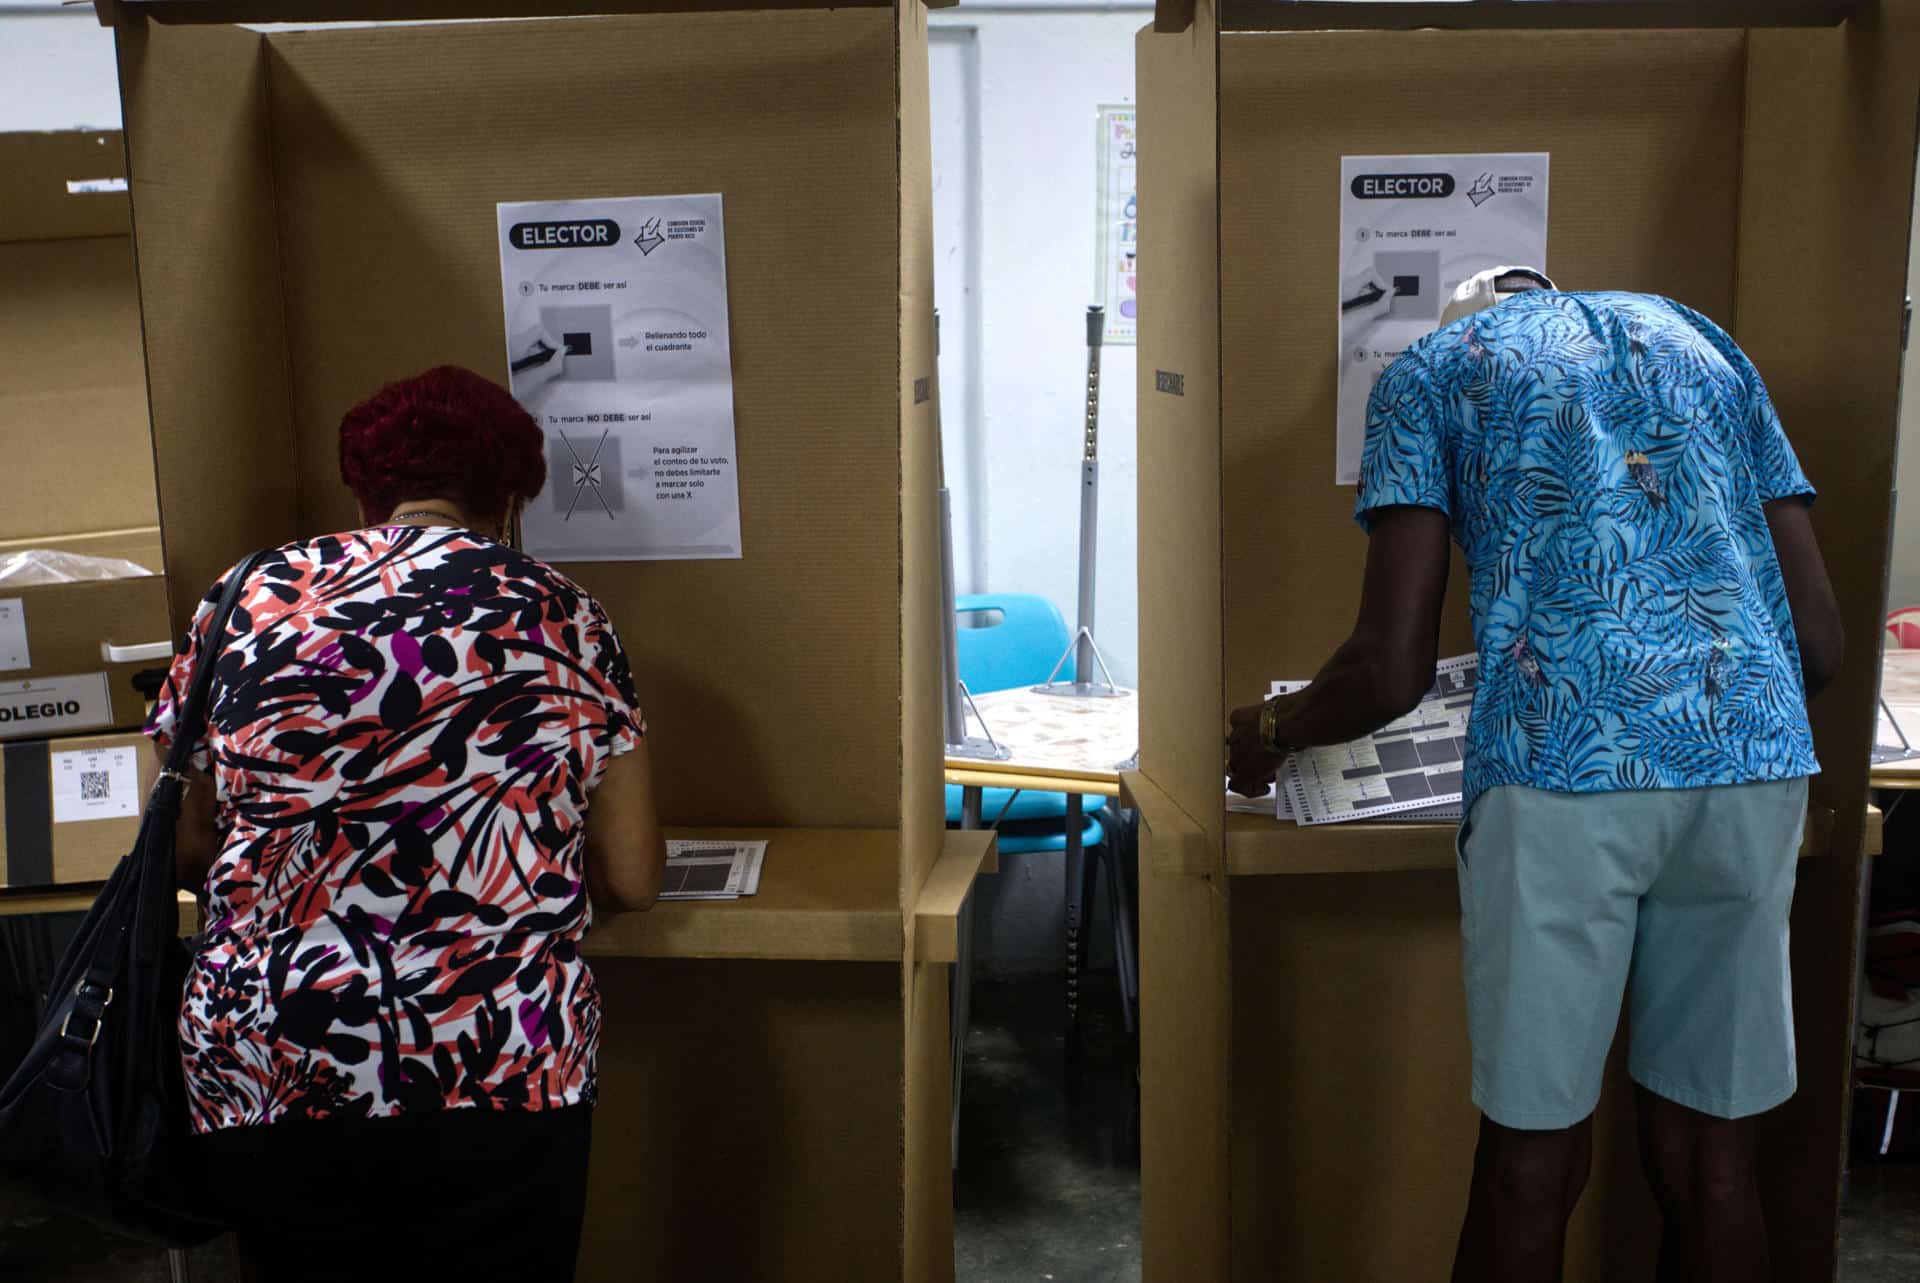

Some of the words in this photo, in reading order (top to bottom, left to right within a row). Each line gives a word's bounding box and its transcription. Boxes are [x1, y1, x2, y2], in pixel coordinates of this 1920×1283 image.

[1363, 178, 1443, 194] ELECTOR
[522, 226, 608, 245] ELECTOR
[1375, 230, 1384, 238] Tu
[539, 283, 548, 292] Tu
[551, 284, 575, 292] marca
[578, 281, 601, 291] DEBE
[616, 280, 627, 290] así
[645, 331, 687, 341] Rellenando
[688, 330, 707, 339] todo
[646, 343, 653, 352] el
[654, 342, 692, 352] cuadrante
[549, 415, 558, 424] Tu
[561, 415, 584, 424] marca
[587, 414, 600, 423] NO
[603, 413, 625, 423] DEBE
[640, 412, 651, 421] así
[653, 446, 670, 454] Para
[671, 445, 698, 456] agilizar
[654, 457, 661, 465] el
[662, 457, 687, 465] conteo
[689, 456, 699, 465] de
[700, 457, 709, 465] tu
[655, 469, 664, 477] no
[665, 468, 688, 477] debes
[689, 467, 721, 476] limitarte
[662, 480, 688, 488] marcar
[689, 479, 704, 488] solo
[656, 492, 670, 500] con
[671, 492, 686, 500] una
[686, 491, 693, 500] X
[0, 701, 80, 722] OLEGIO
